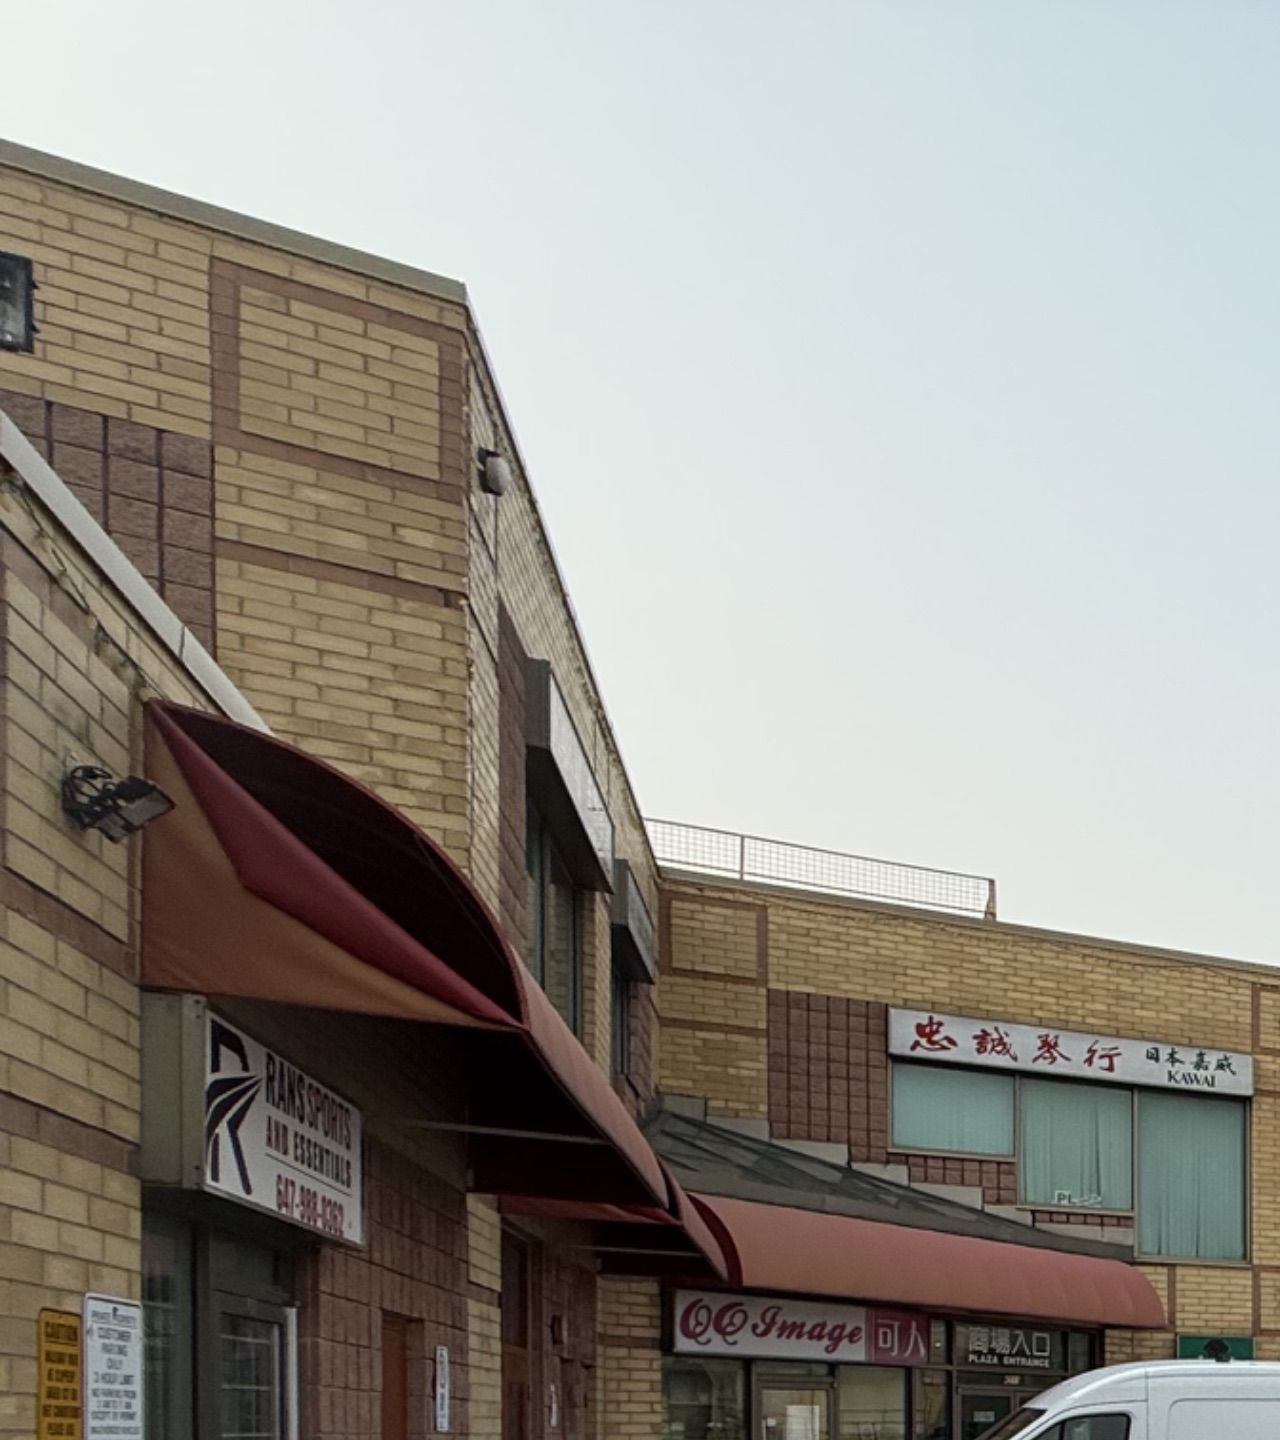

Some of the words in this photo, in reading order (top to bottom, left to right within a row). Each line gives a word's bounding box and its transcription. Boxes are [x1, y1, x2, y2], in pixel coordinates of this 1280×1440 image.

[910, 1015, 1123, 1073] 忠誠琴行
[1168, 1070, 1216, 1088] KAWAI
[265, 1115, 289, 1156] AND
[293, 1131, 352, 1188] ESSENTIALS
[751, 1305, 862, 1353] Image
[876, 1319, 927, 1358] 可人
[968, 1354, 999, 1364] PLAZA
[1003, 1356, 1050, 1368] ENTRANCE
